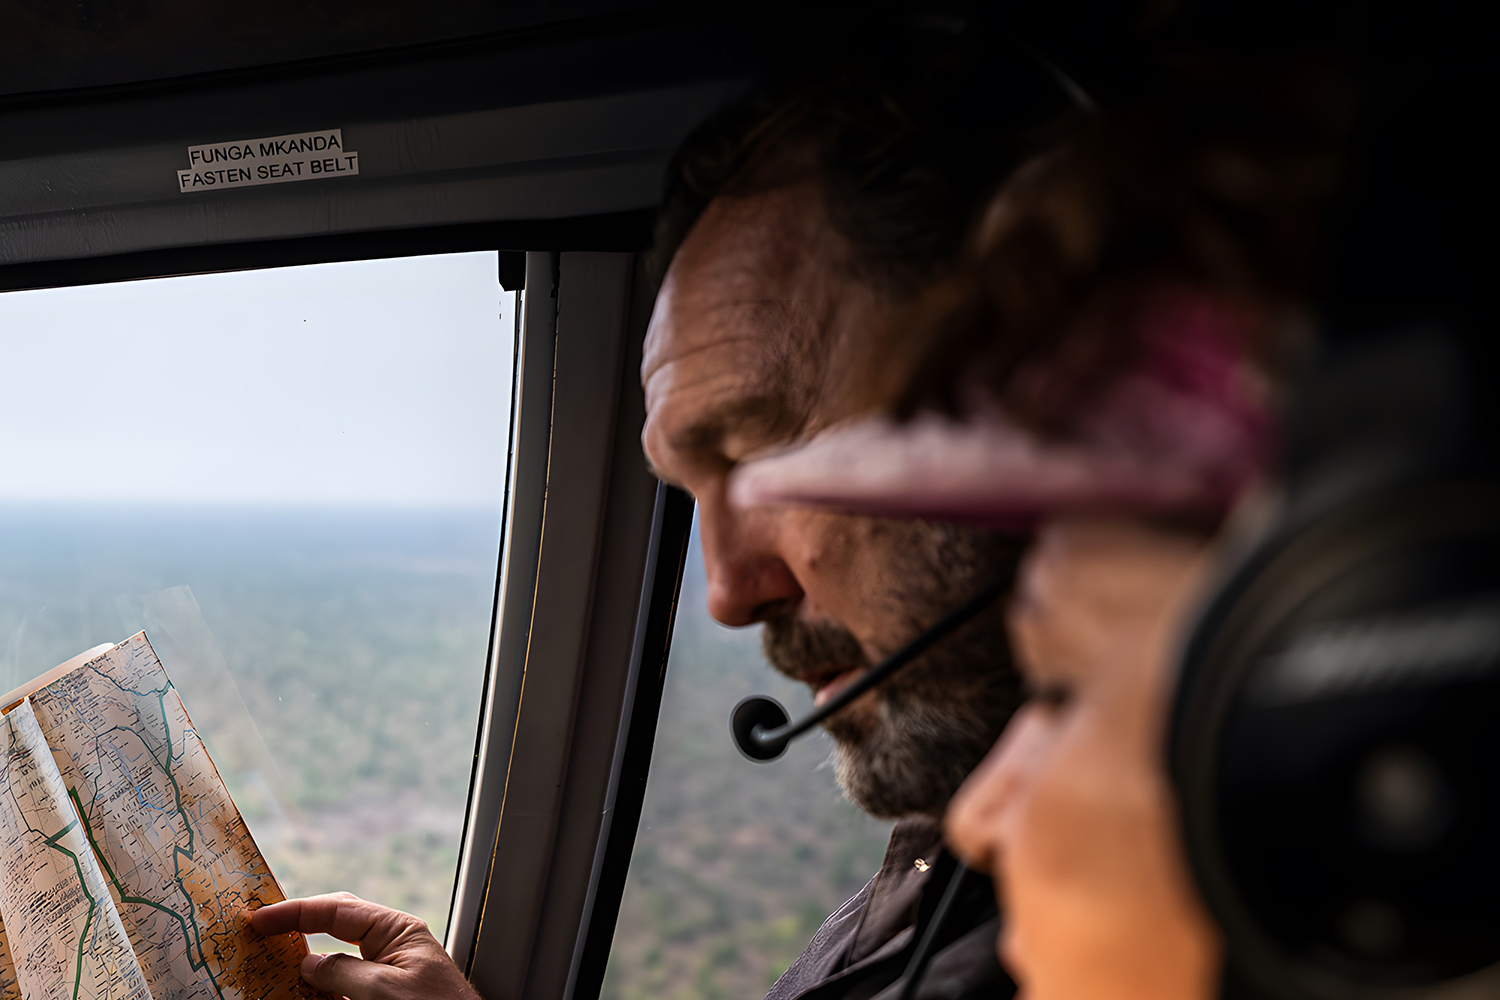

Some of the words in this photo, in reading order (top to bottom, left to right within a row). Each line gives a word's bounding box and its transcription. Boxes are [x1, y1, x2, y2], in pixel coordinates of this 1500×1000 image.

[190, 144, 256, 165] FUNGA
[259, 134, 341, 157] MKANDA
[180, 167, 252, 188] FASTEN
[257, 161, 304, 179] SEAT
[310, 155, 357, 174] BELT
